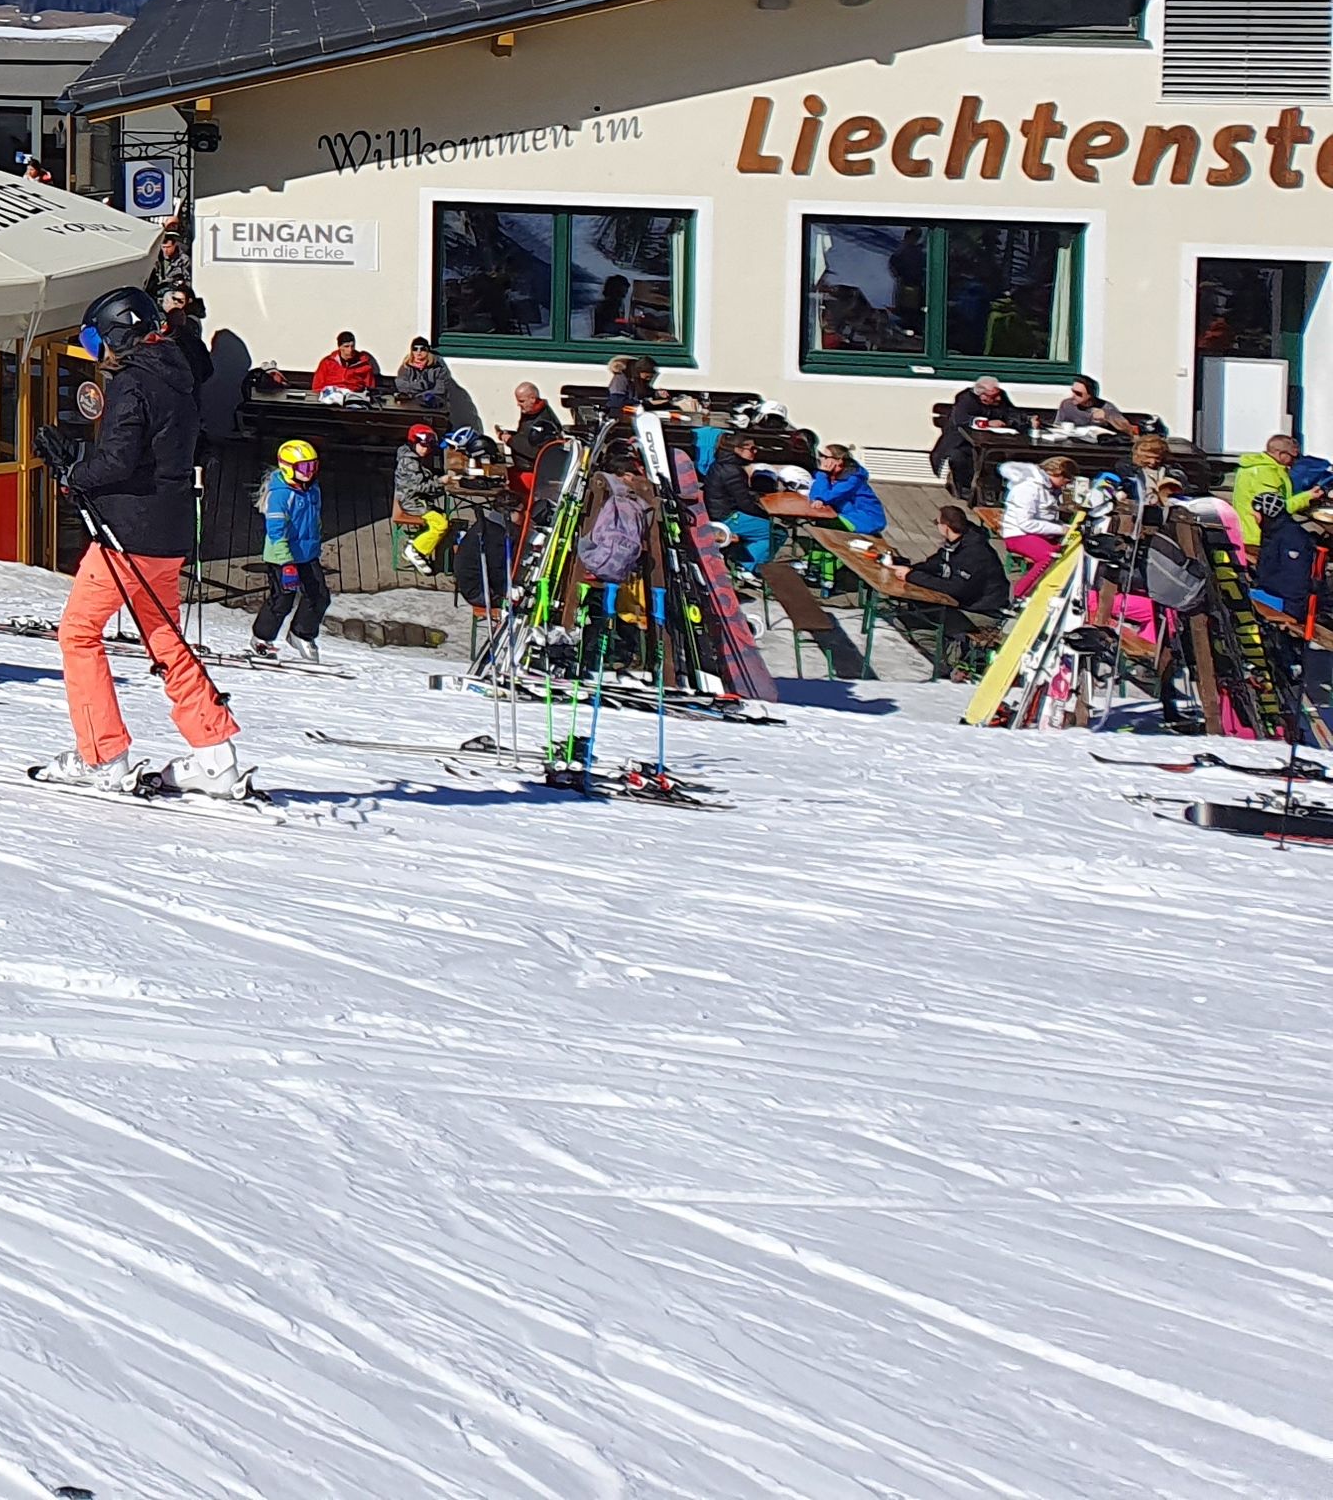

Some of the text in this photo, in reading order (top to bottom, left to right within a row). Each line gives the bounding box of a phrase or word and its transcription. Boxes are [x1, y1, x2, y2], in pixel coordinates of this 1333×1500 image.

[318, 105, 643, 175] Willkommen im
[43, 221, 130, 236] VODKA
[232, 222, 354, 244] EINGANG
[241, 245, 345, 260] um die Ecke
